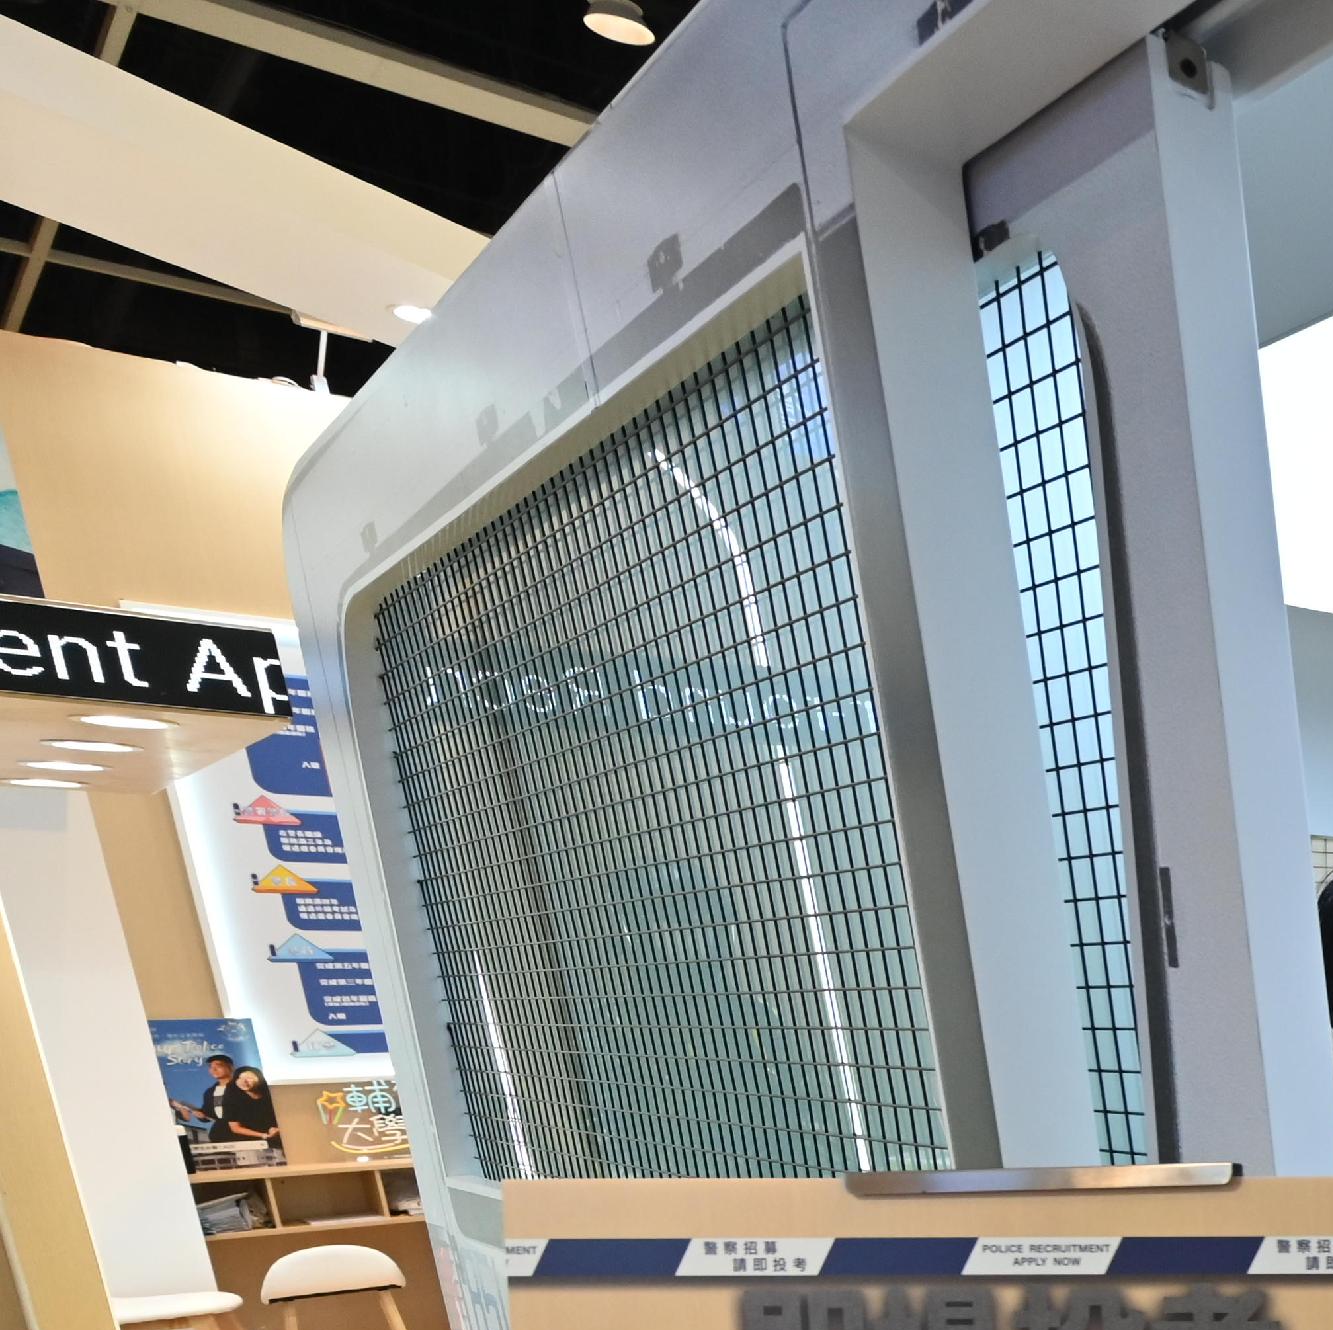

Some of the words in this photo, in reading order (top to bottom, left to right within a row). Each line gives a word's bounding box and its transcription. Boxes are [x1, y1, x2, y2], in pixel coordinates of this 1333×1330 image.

[0, 629, 150, 688] ent
[703, 1240, 778, 1255] 警察招募
[982, 1243, 1023, 1254] POLICE
[1029, 1243, 1110, 1254] RECRUITMENT
[732, 1257, 807, 1273] 請即投考
[1013, 1256, 1047, 1267] APPLY
[1053, 1256, 1082, 1267] NOW
